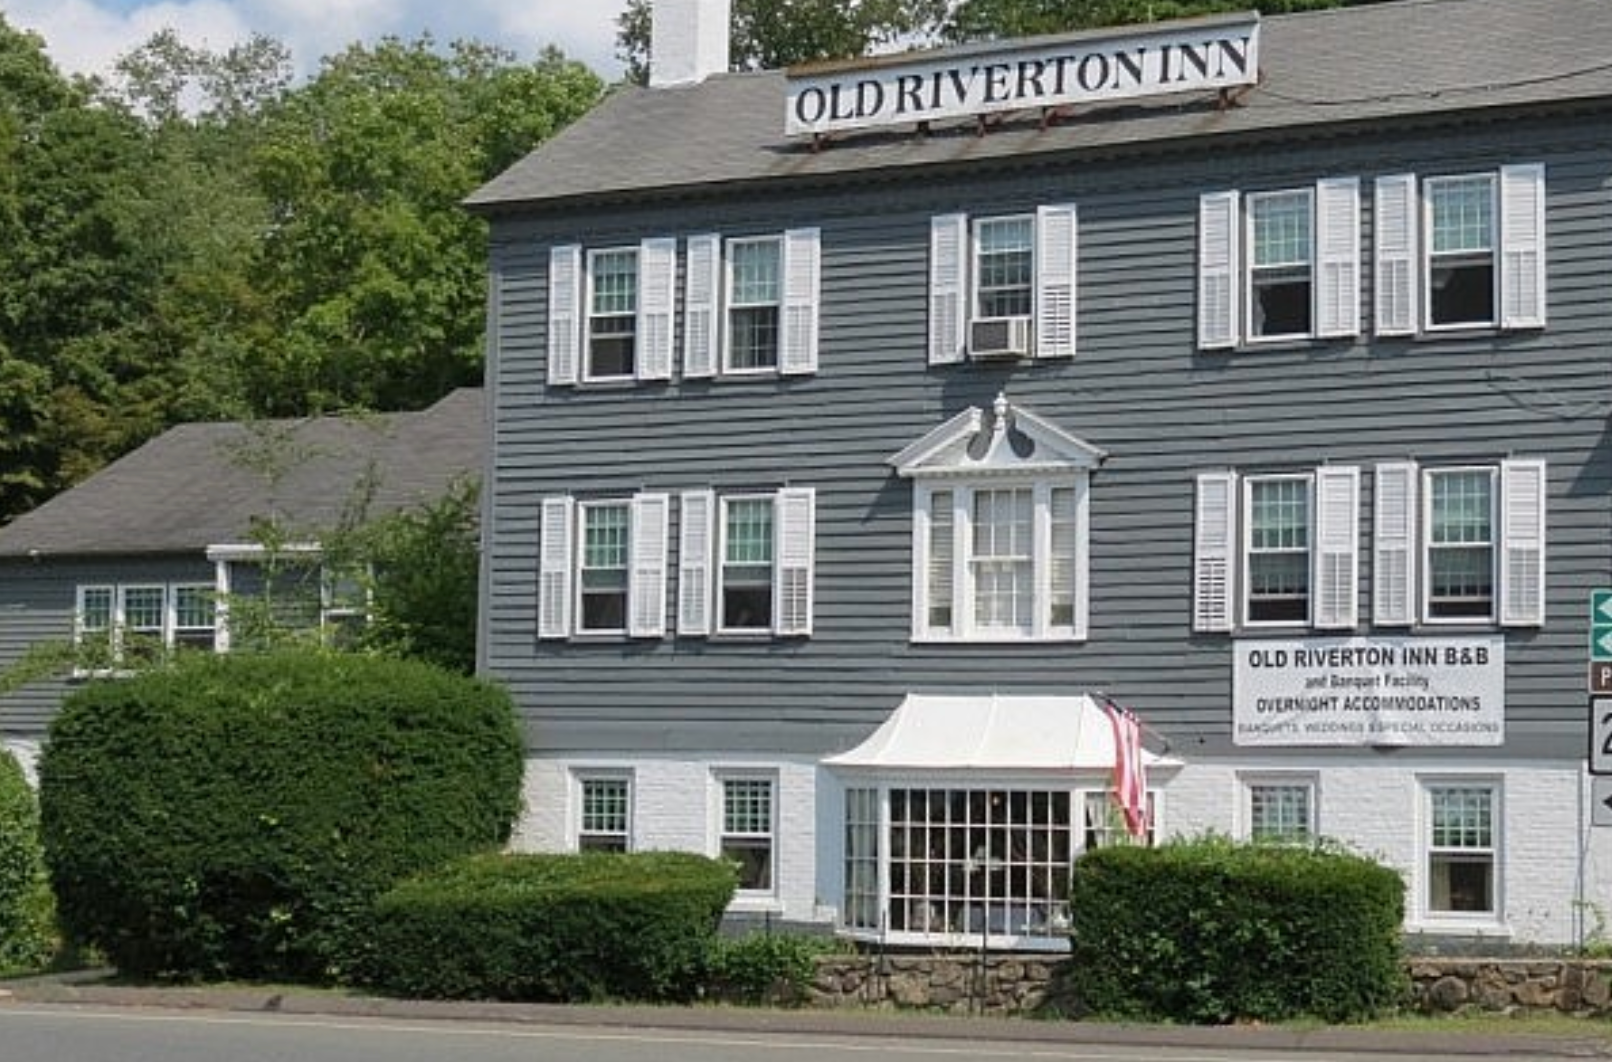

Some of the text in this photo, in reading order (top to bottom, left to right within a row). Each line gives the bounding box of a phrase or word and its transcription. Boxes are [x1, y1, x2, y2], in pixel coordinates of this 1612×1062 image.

[795, 37, 1250, 124] OLD RIVERTON INN
[1249, 647, 1489, 668] OLD RIVERTON INN B&B
[1305, 674, 1429, 691] and Banquet Facility
[1257, 696, 1481, 713] OVERNIGHT ACCOMMODATIONS
